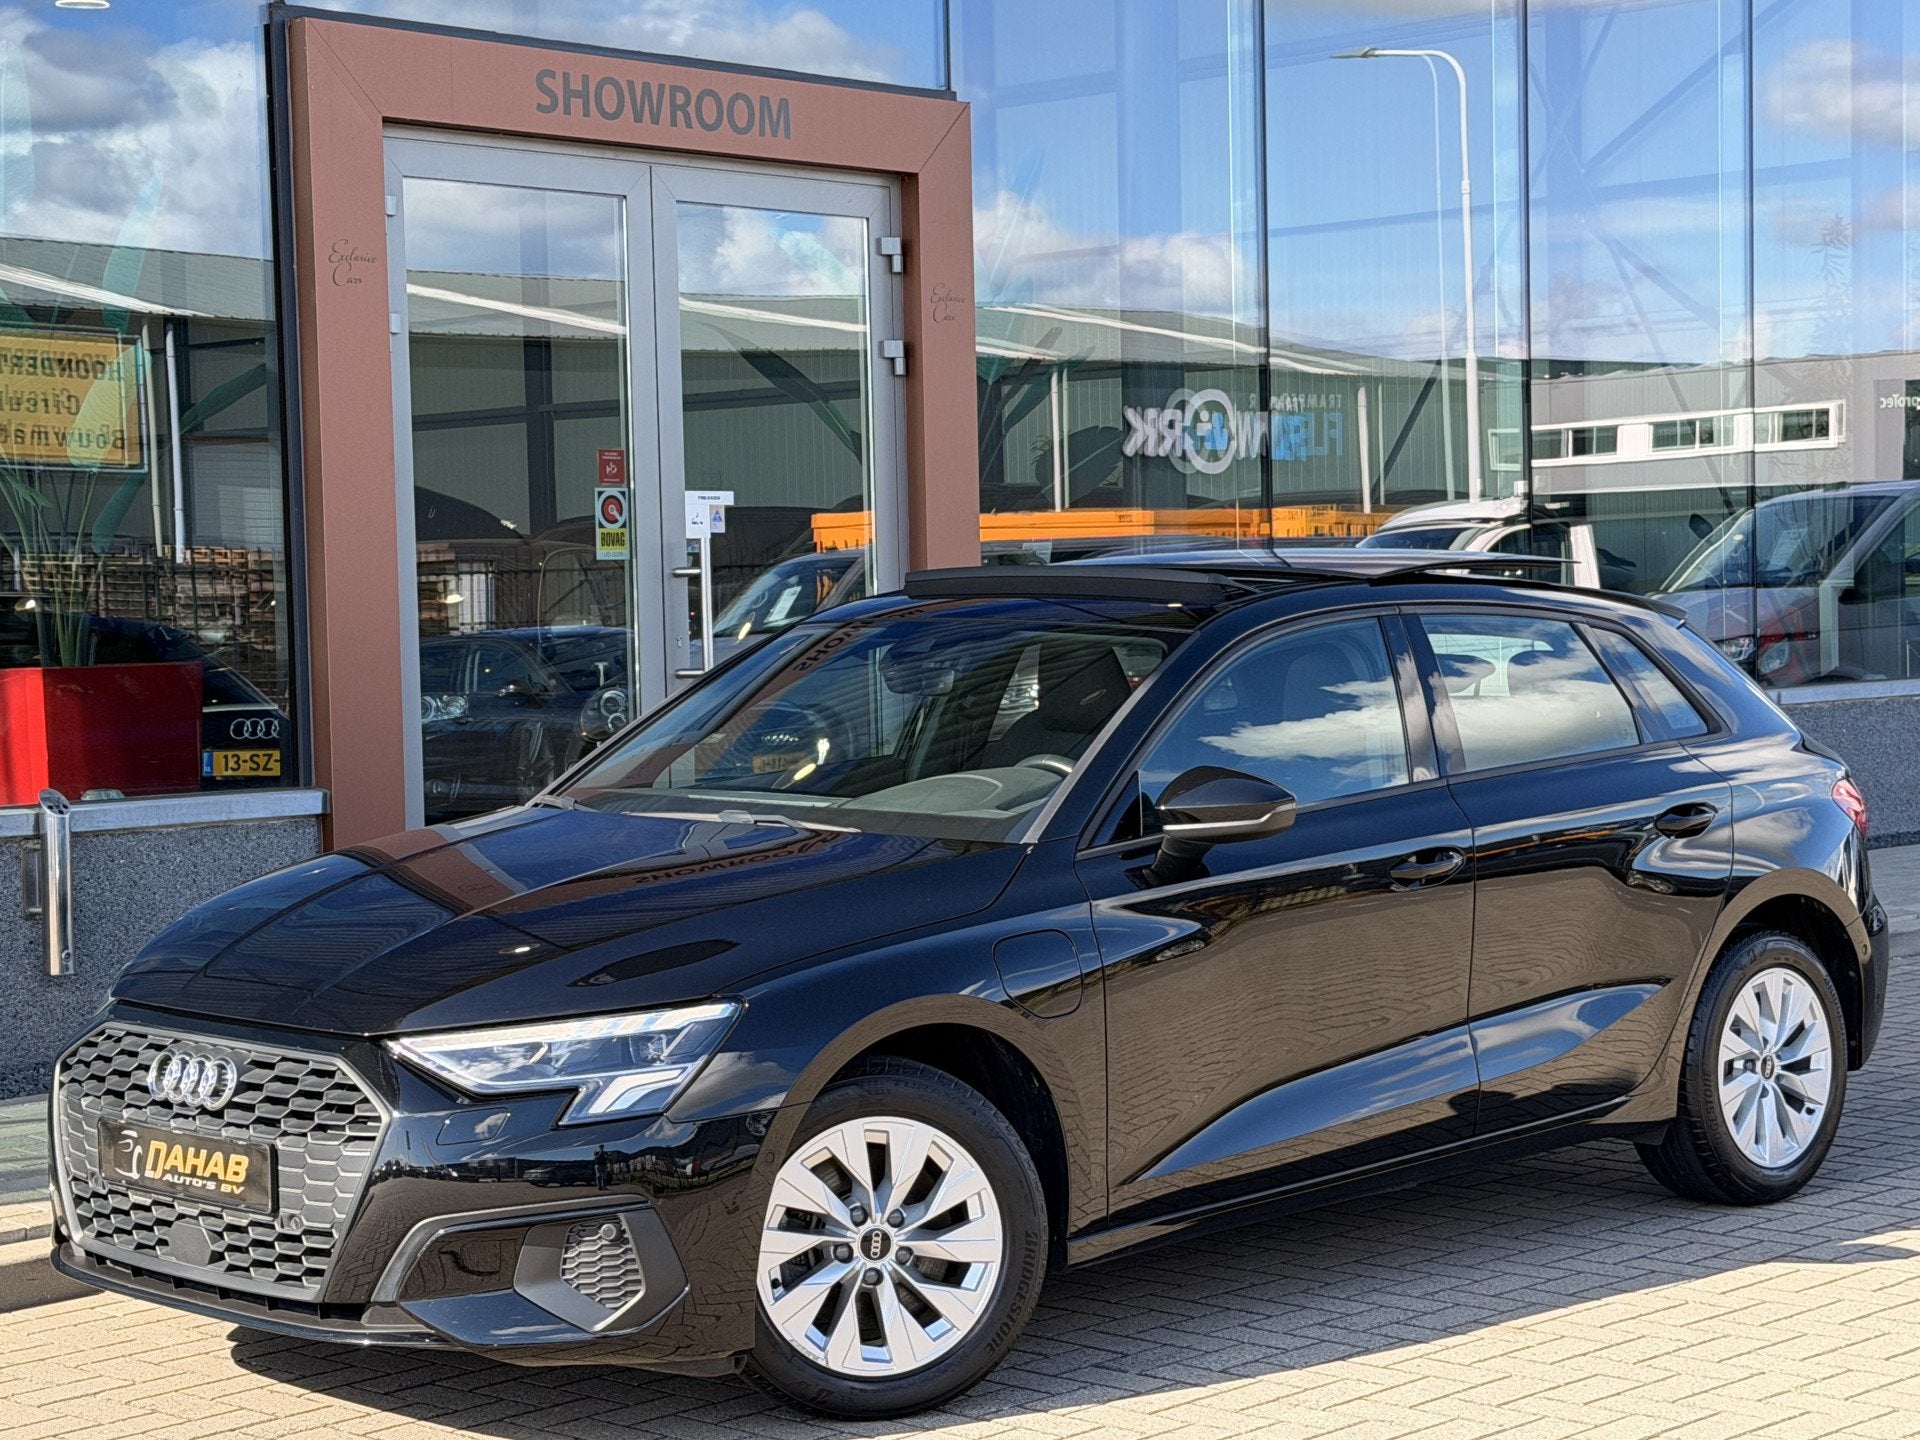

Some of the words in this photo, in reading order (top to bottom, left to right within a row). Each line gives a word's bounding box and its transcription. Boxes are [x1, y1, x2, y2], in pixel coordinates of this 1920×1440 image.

[535, 68, 792, 140] SHOWROOM
[333, 262, 362, 287] Cars
[600, 531, 626, 547] BOVAG
[145, 1140, 249, 1183] DAHAB
[162, 1172, 217, 1192] AUTO'S
[220, 1183, 245, 1195] BV
[984, 1231, 1039, 1355] BRIDGESTONE
